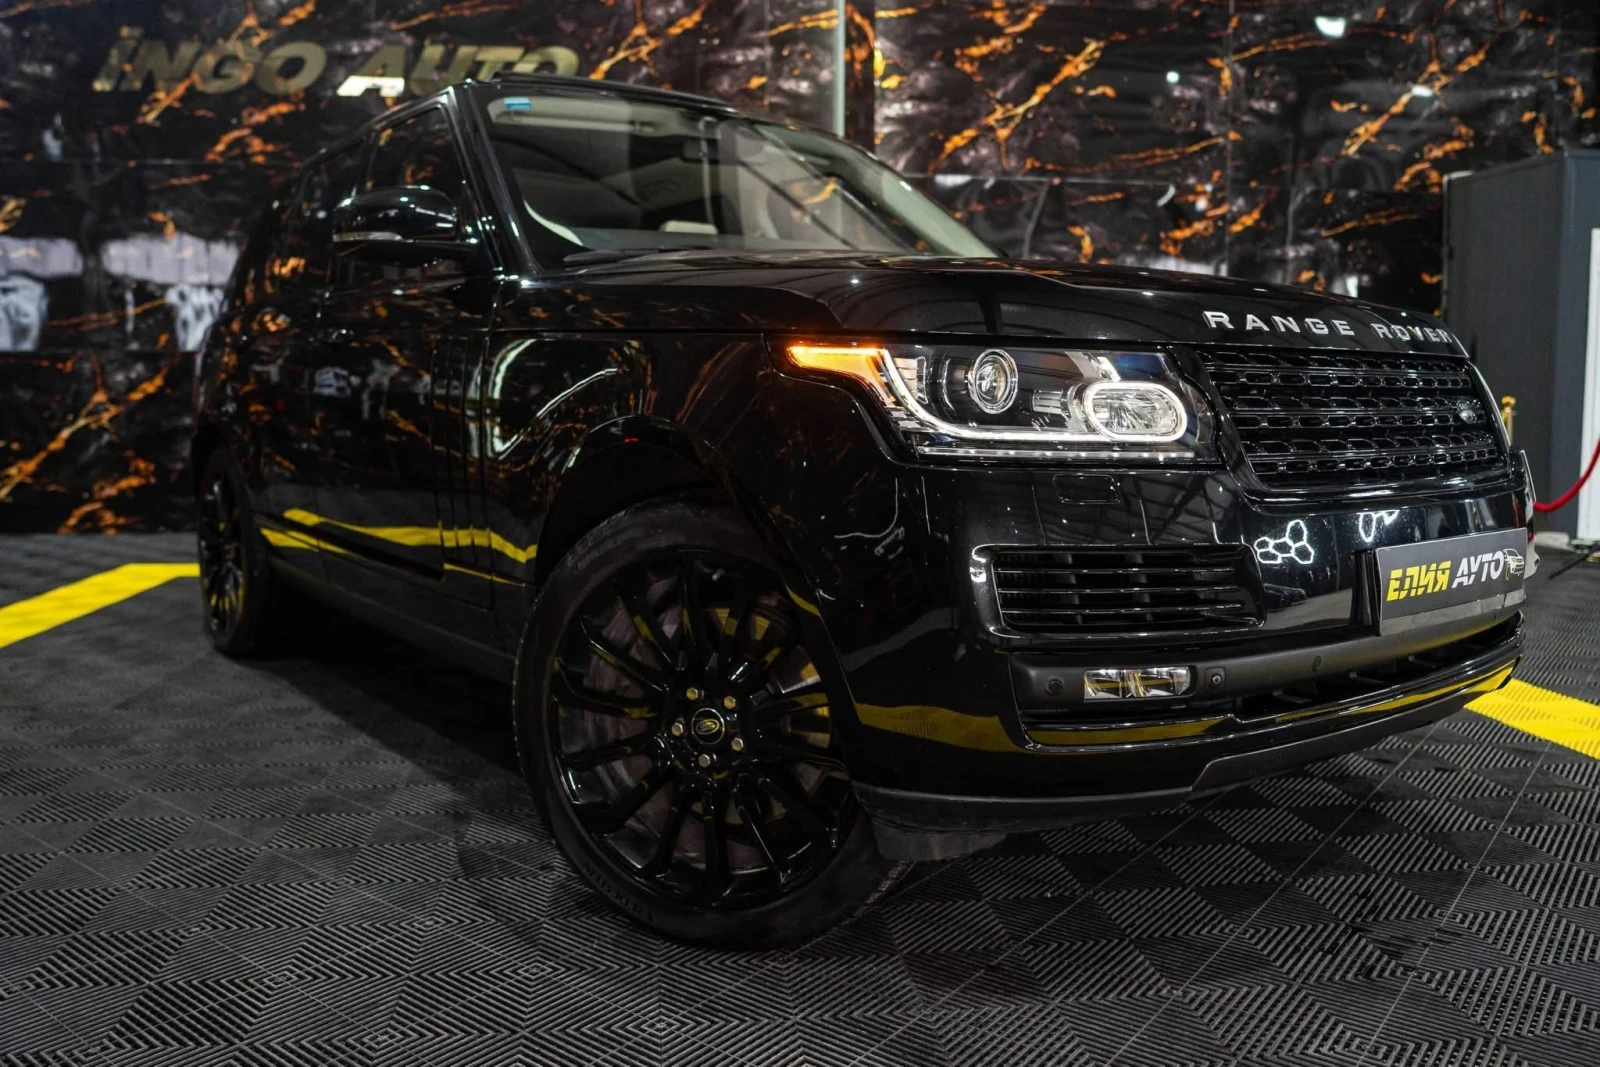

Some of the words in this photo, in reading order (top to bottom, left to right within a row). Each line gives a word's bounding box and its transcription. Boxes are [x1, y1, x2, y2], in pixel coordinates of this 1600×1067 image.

[336, 43, 580, 97] AUTO
[1202, 310, 1356, 337] RANGE
[1370, 322, 1453, 344] ROVER
[1386, 560, 1451, 602] ЕЛИЯ
